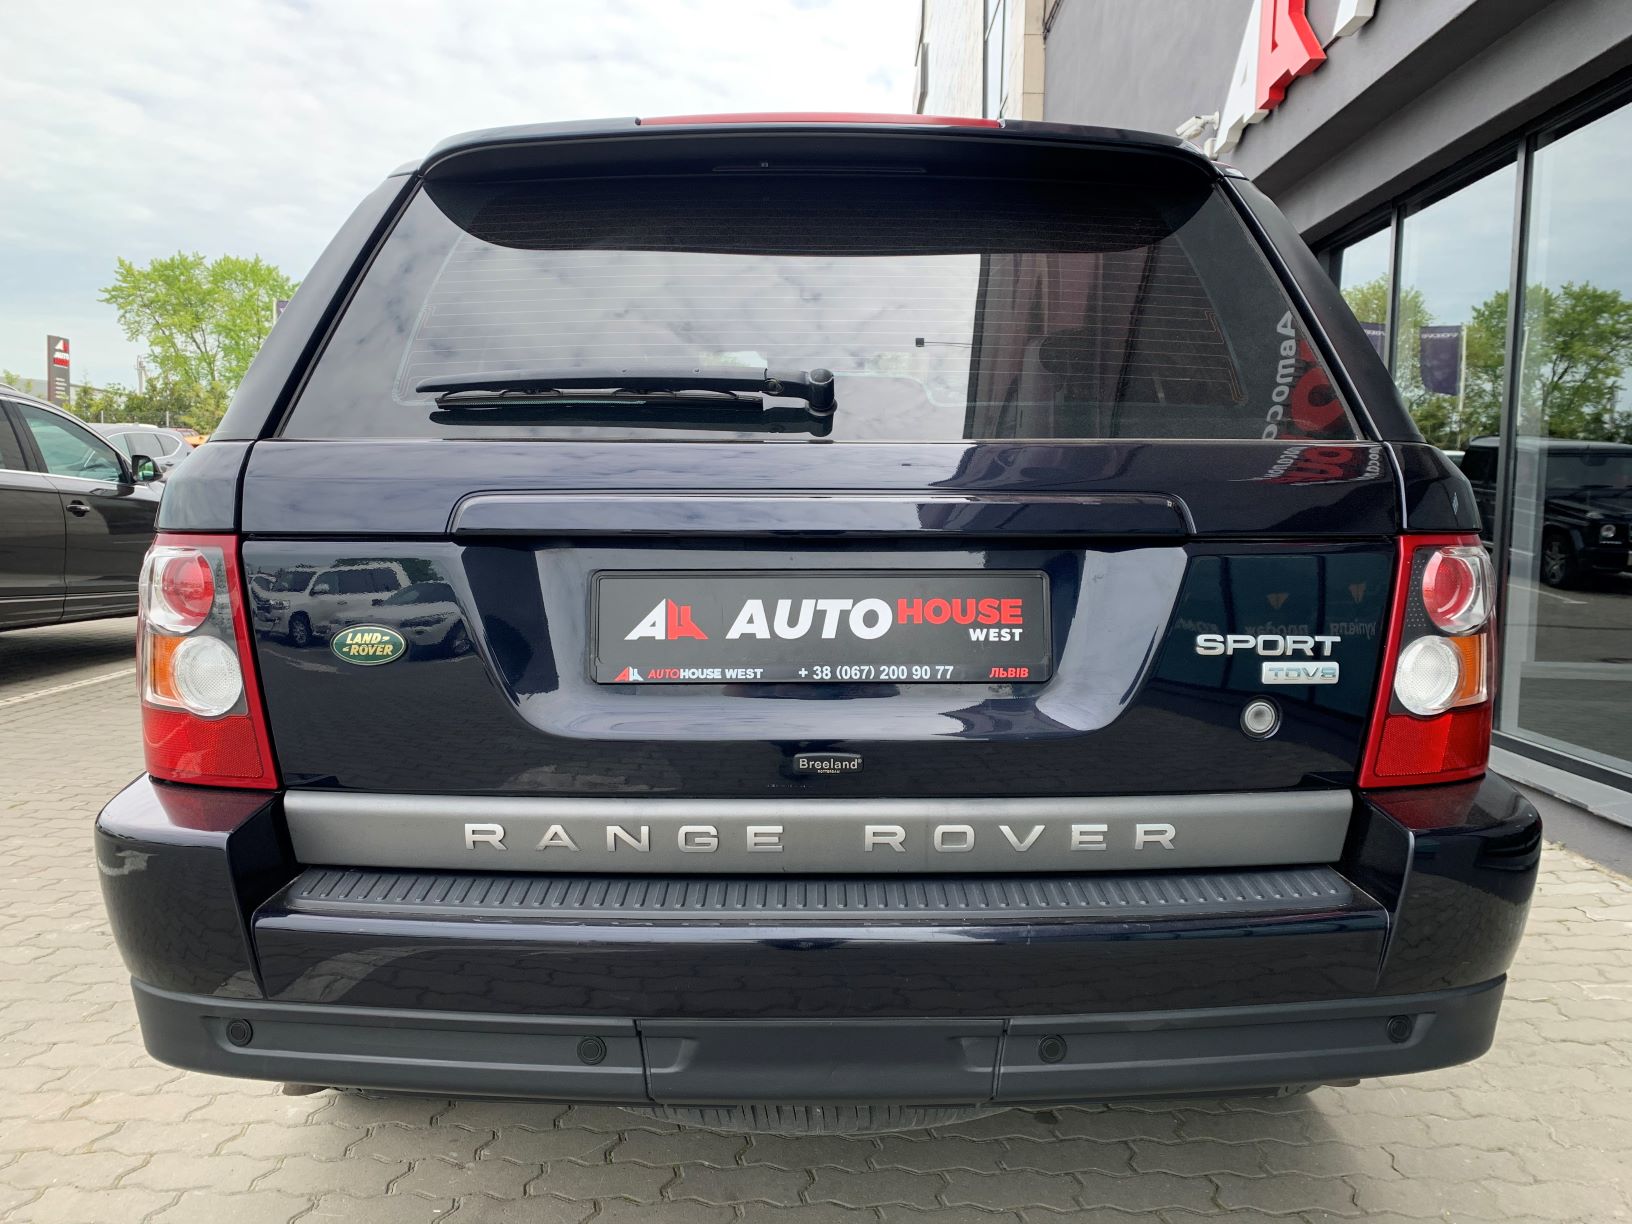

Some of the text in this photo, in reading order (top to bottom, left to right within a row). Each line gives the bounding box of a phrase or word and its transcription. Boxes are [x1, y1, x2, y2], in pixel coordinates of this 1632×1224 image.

[725, 598, 893, 640] AUTO
[897, 598, 1023, 625] HOUSE
[969, 628, 1023, 642] WEST
[1196, 634, 1341, 656] SPORT
[648, 668, 763, 680] AUTOHOUSE WEST
[813, 667, 832, 680] 38
[836, 666, 875, 681] (067)
[880, 667, 908, 680] 200
[912, 667, 932, 680] 90
[935, 667, 954, 680] 77
[989, 667, 1029, 679] ЛЬВІВ
[1268, 666, 1338, 683] TDV8
[464, 823, 1177, 853] RANGE ROVER
